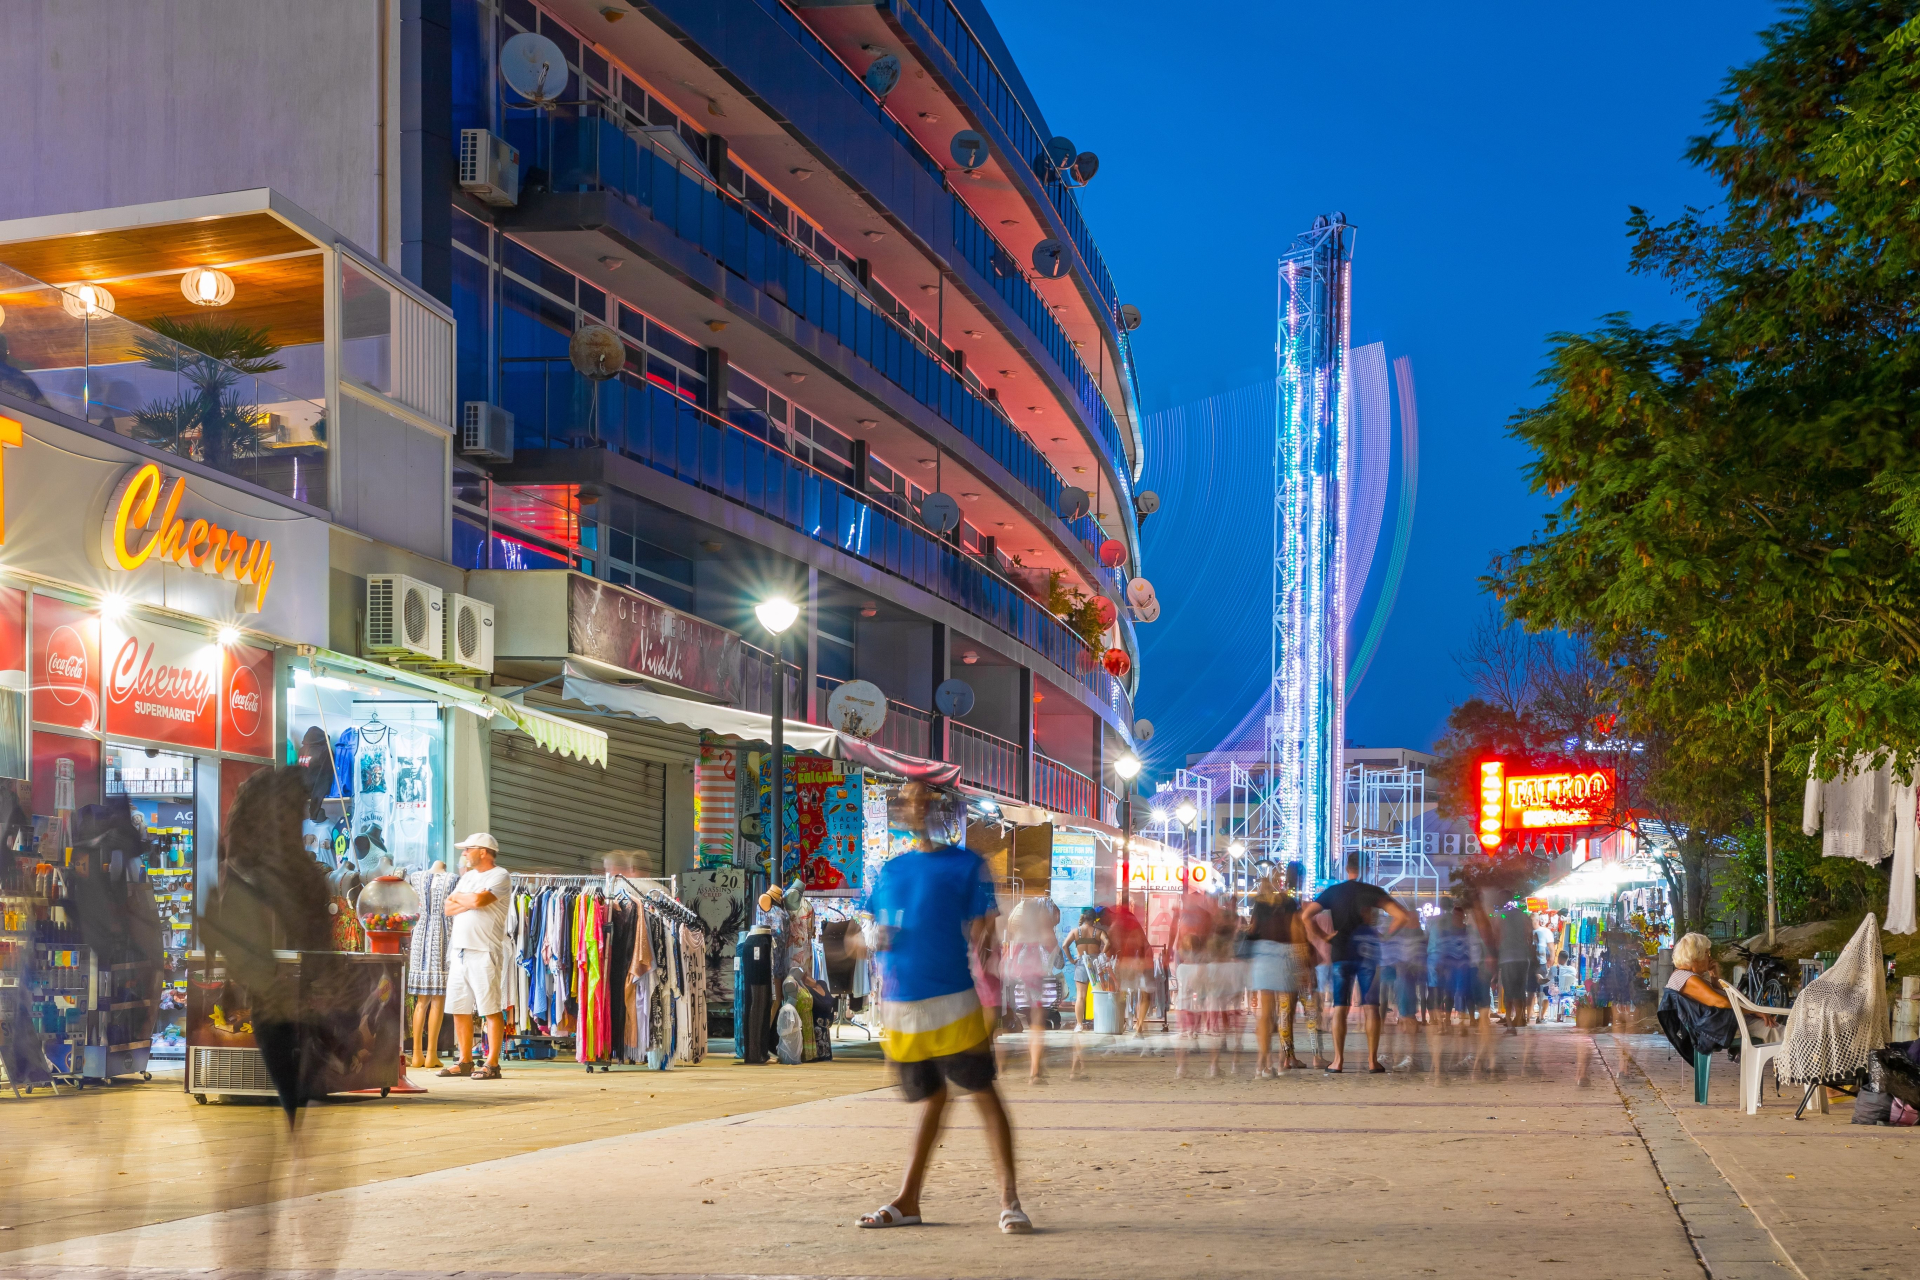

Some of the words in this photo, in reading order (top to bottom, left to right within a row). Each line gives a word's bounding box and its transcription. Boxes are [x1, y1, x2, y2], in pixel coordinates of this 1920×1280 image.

[113, 464, 275, 614] Cherry
[618, 596, 703, 648] GELATERIA
[48, 652, 85, 679] Coca-Cola
[640, 628, 684, 681] Vivaldi
[109, 636, 211, 717] Cherry
[134, 700, 196, 723] SUPERMARKET
[231, 689, 260, 713] Coca-Cola
[1508, 773, 1607, 808] TATTOO
[720, 874, 738, 889] 20
